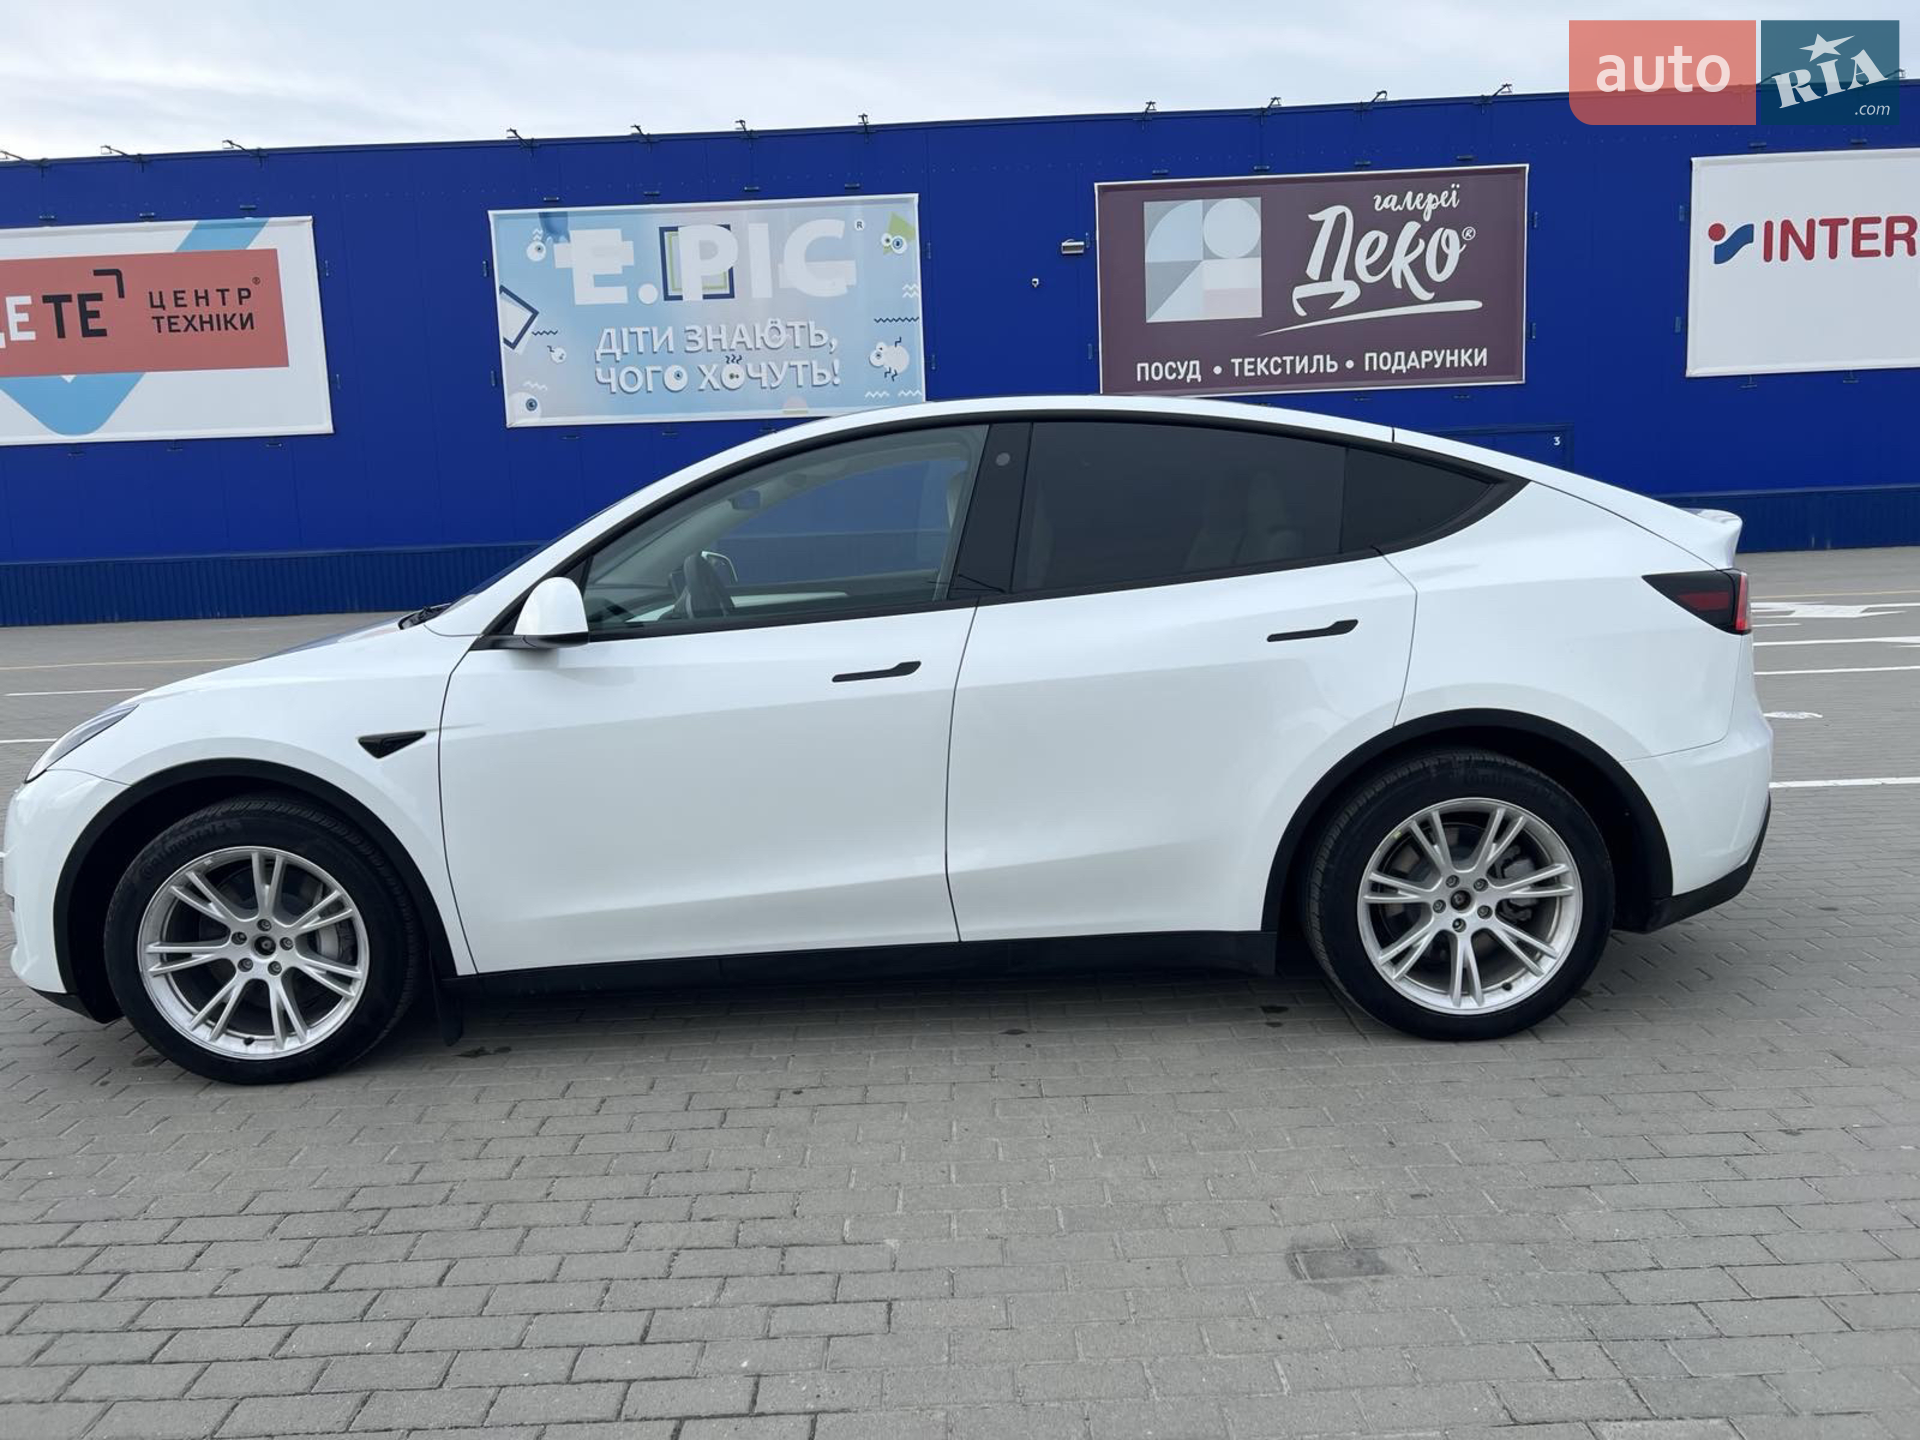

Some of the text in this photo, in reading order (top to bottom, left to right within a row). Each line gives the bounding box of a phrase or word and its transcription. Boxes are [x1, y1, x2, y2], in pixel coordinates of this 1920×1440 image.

[1371, 184, 1461, 222] галереї
[1763, 215, 1918, 263] INTER
[1292, 205, 1466, 317] Деко
[149, 288, 251, 310] ЦЕНТР
[0, 293, 108, 348] ЕТЕ
[152, 313, 255, 333] ТЕХНІКИ
[593, 325, 675, 363] ДІТИ
[595, 358, 841, 393] ЧОГО ХОЧУТЬ!
[1136, 348, 1488, 382] ПОСУД ТЕКСТИЛЬ ПОДАРУНКИ
[1553, 436, 1561, 446] 3
